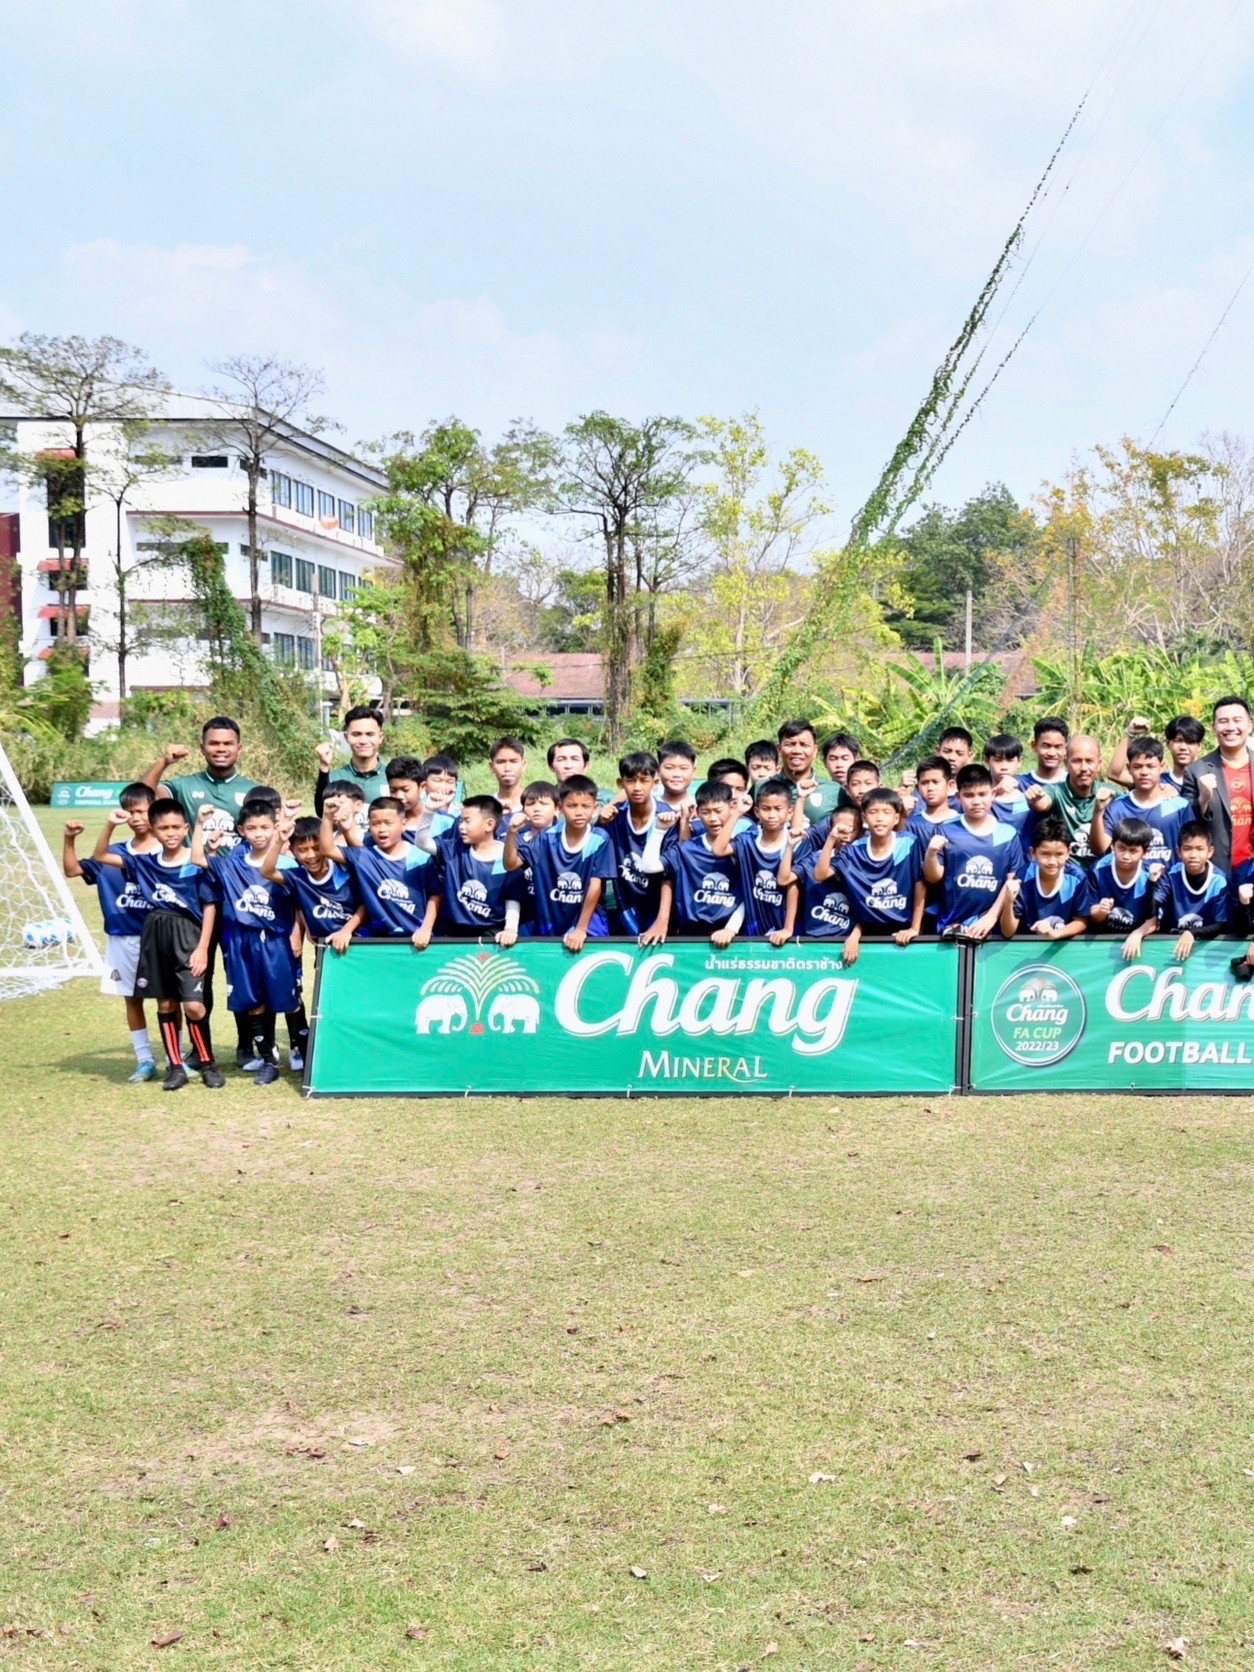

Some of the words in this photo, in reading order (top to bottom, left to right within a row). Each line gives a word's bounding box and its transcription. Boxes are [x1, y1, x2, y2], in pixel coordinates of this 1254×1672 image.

[957, 872, 998, 892] Chang
[550, 888, 584, 904] Chan
[694, 888, 736, 908] Chang
[865, 895, 908, 910] Chang
[810, 905, 850, 930] Chang
[705, 954, 843, 970] น้ำแร่ธรรมชาติตราช้าง
[554, 950, 859, 1057] Chang
[1006, 1003, 1069, 1025] Chang
[1013, 1027, 1029, 1039] FA
[1033, 1027, 1062, 1039] CUP
[1015, 1041, 1060, 1052] 2022/23
[1107, 1041, 1252, 1065] FOOTBALL
[637, 1050, 768, 1083] MINERAL
